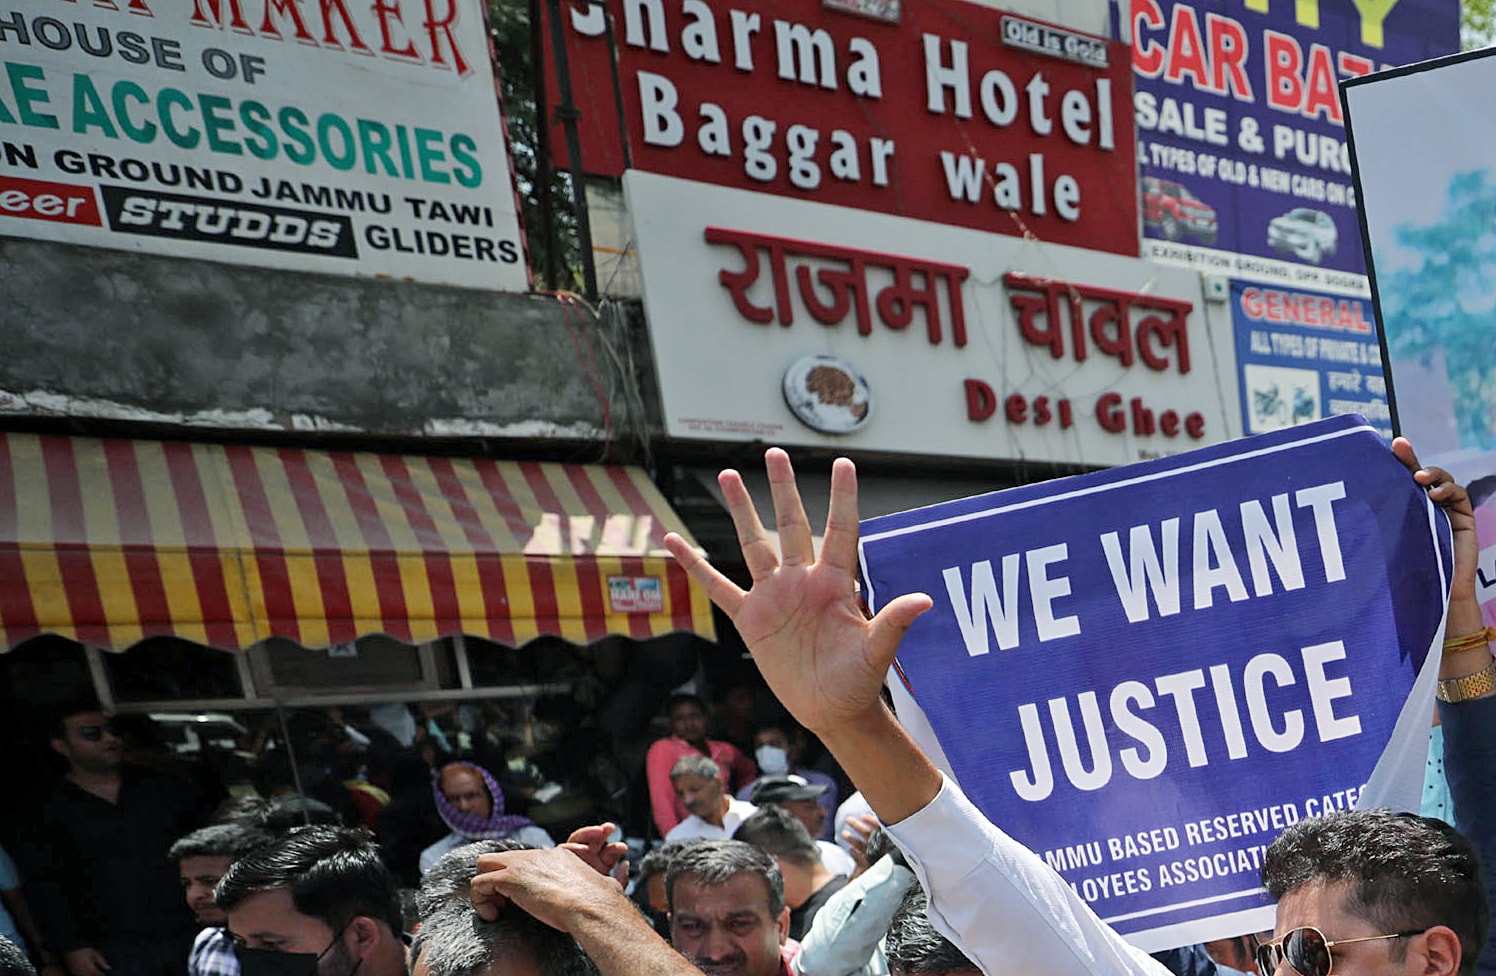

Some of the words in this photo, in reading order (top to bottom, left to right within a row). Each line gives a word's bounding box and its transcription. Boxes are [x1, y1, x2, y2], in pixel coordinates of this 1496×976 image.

[0, 11, 186, 72] HOUSE
[201, 47, 266, 85] OF
[1005, 19, 1038, 44] Old
[1043, 27, 1061, 49] is
[1064, 36, 1108, 62] Gold
[1131, 1, 1254, 102] CAR
[1263, 28, 1385, 125] BA
[921, 32, 1115, 151] Hotel
[1134, 90, 1229, 147] SALE
[1237, 116, 1265, 155] &
[72, 72, 483, 189] ACCESSORIES
[637, 70, 895, 190] Baggar
[941, 150, 1081, 222] wale
[54, 148, 243, 195] GROUND
[251, 177, 392, 215] JAMMU
[403, 197, 494, 229] TAWI
[1197, 153, 1217, 179] OF
[1218, 157, 1247, 185] OLD
[118, 195, 342, 249] STUDDS
[363, 224, 519, 265] GLIDERS
[704, 226, 970, 349] राजमा
[1004, 270, 1194, 375] चावल
[1241, 286, 1372, 335] GENERAL
[963, 378, 1071, 429] Desi
[1096, 391, 1206, 439] Ghee
[941, 542, 1082, 658] WE
[1100, 479, 1348, 624] WANT
[1008, 640, 1363, 803] JUSTICE
[1037, 840, 1102, 873] MMU
[1106, 826, 1180, 861] BASED
[1184, 803, 1299, 850] RESERVED
